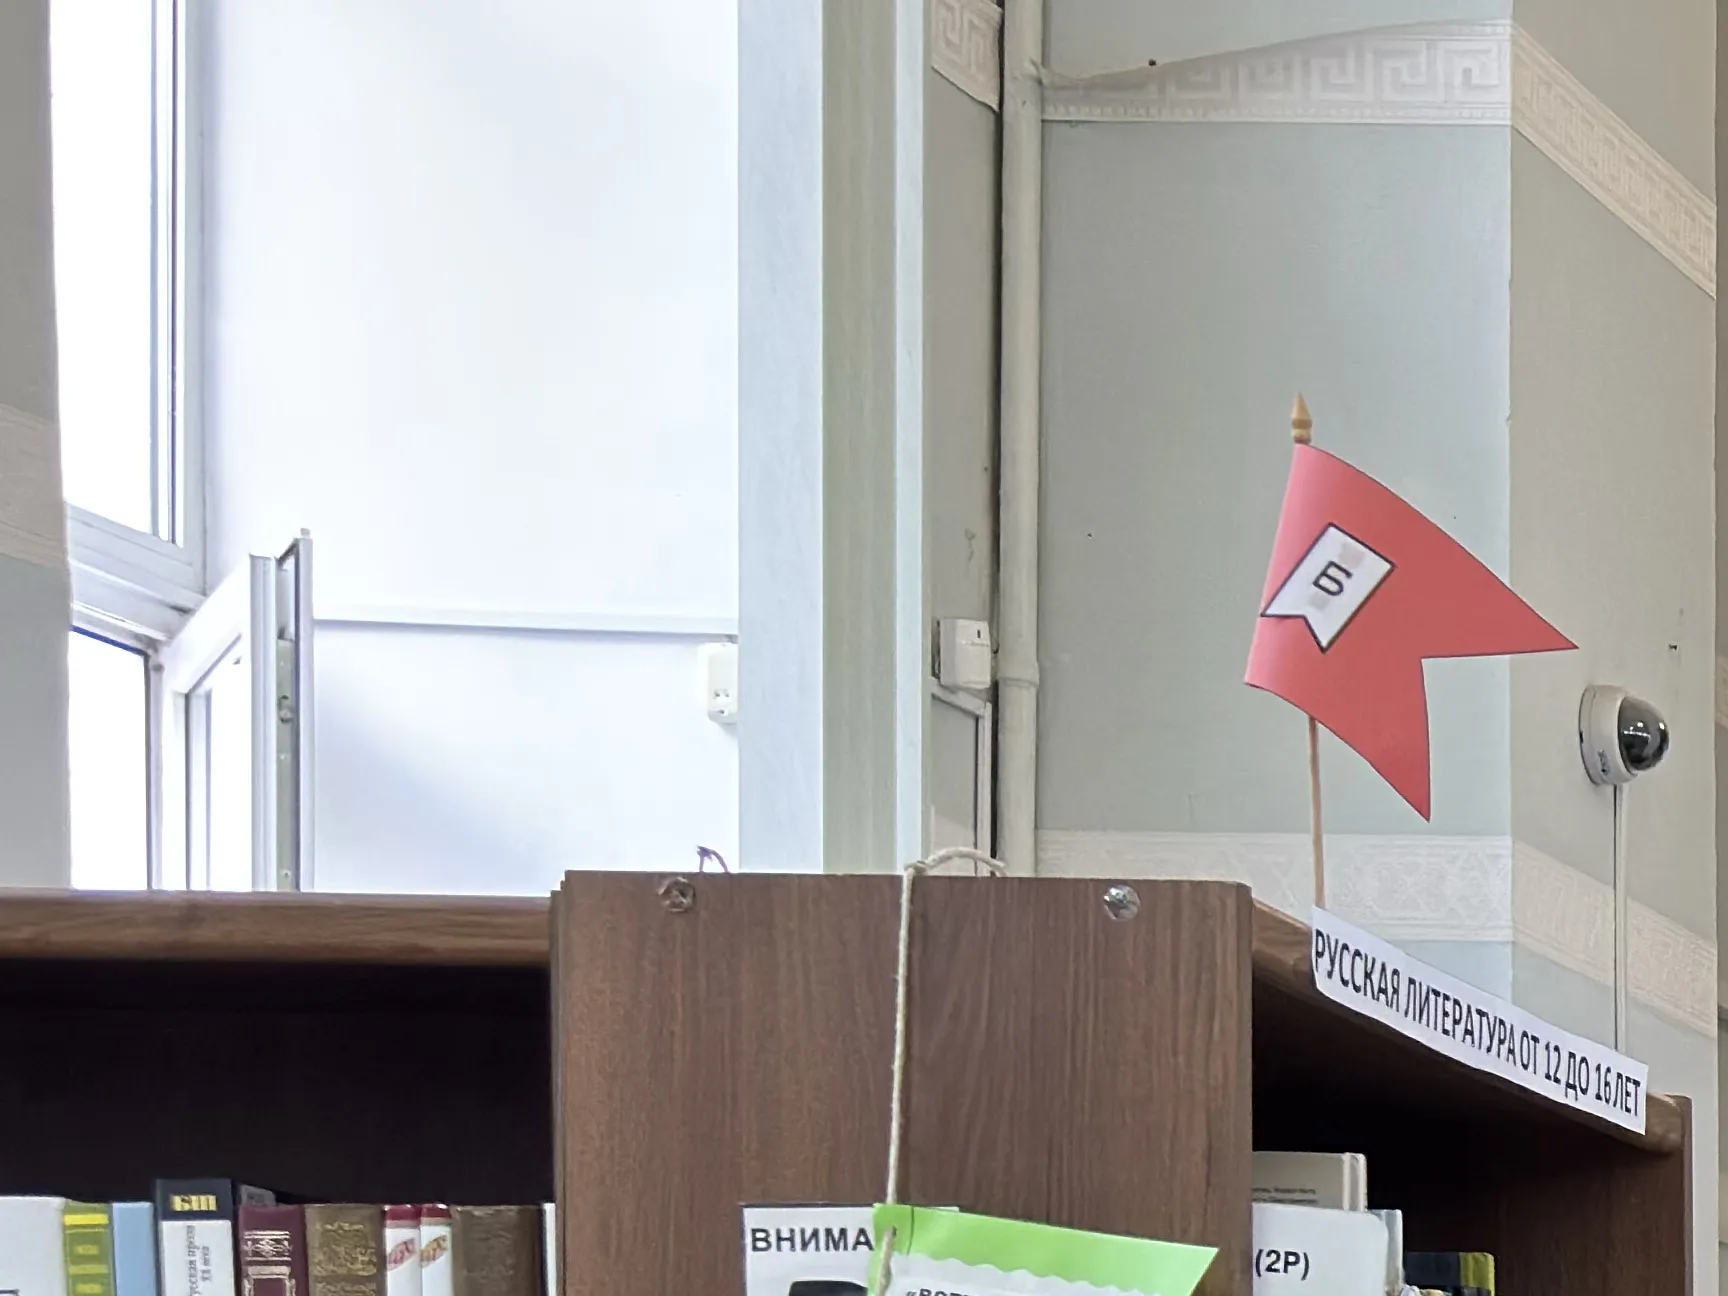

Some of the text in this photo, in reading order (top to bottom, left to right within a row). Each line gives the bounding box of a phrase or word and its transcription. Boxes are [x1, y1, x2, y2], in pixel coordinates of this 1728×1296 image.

[1313, 560, 1353, 597] Б
[1314, 930, 1642, 1117] РУССКАЯ ЛИТЕРАТУРА ОТ 12 ДО 16 ЛЕТ
